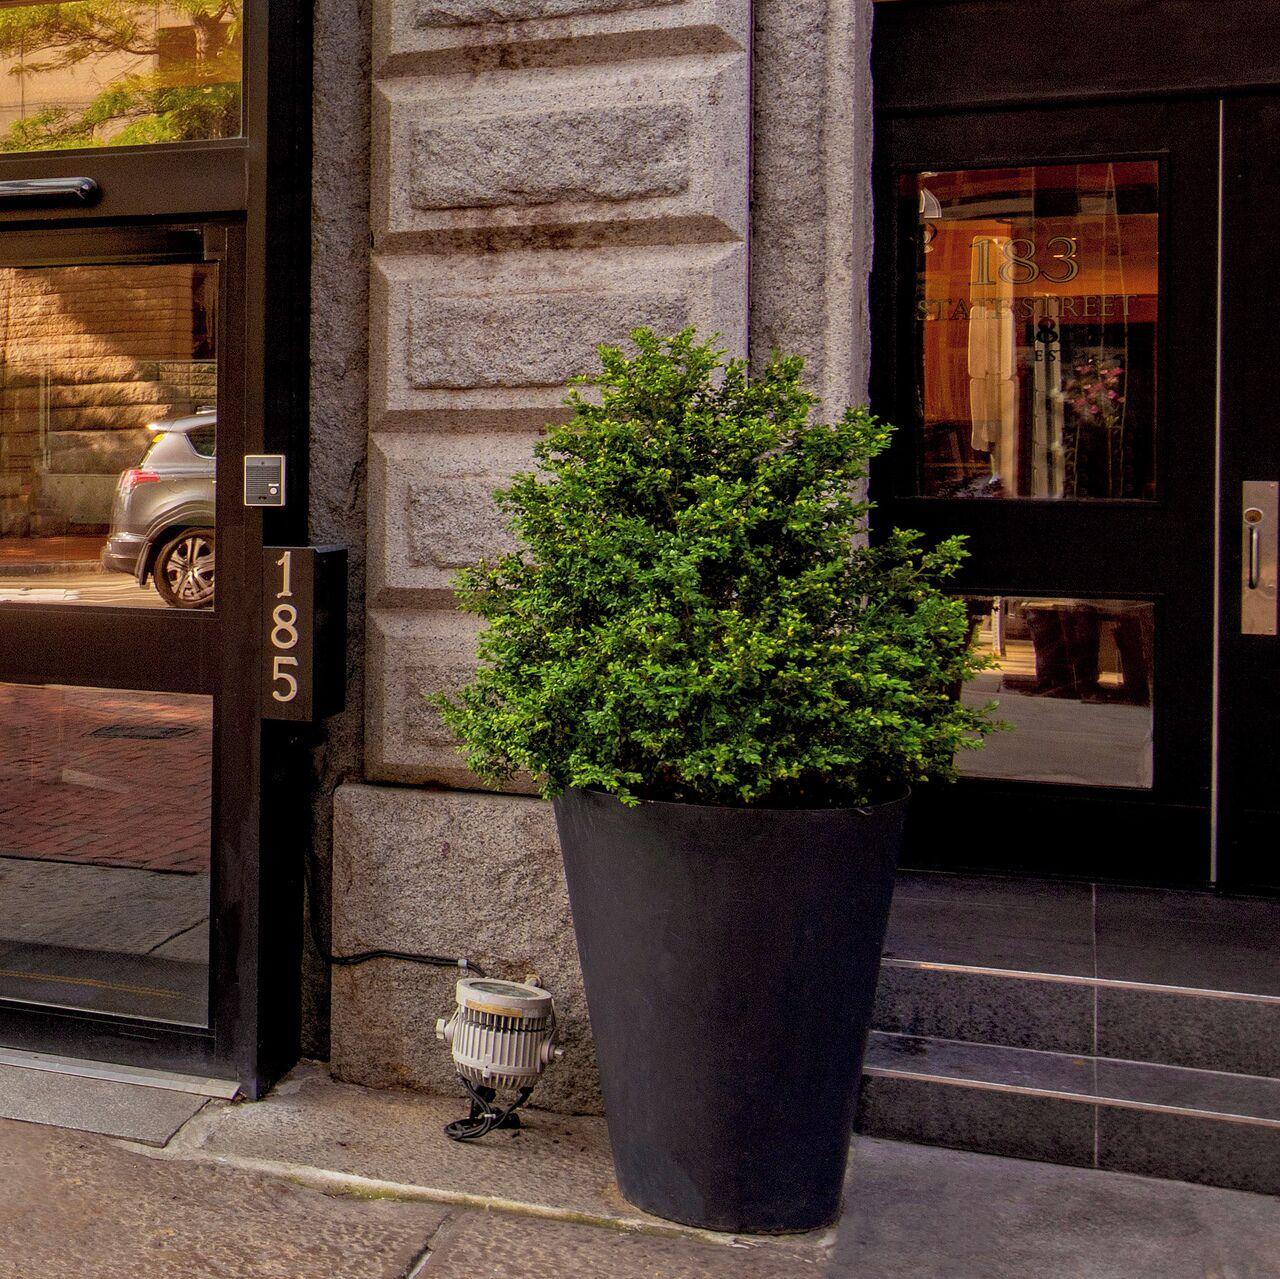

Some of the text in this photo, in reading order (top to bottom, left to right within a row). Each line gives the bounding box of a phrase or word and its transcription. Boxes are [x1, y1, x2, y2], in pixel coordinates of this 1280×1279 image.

[969, 236, 1080, 286] 183
[1020, 293, 1141, 319] STREET
[270, 550, 299, 703] 185
